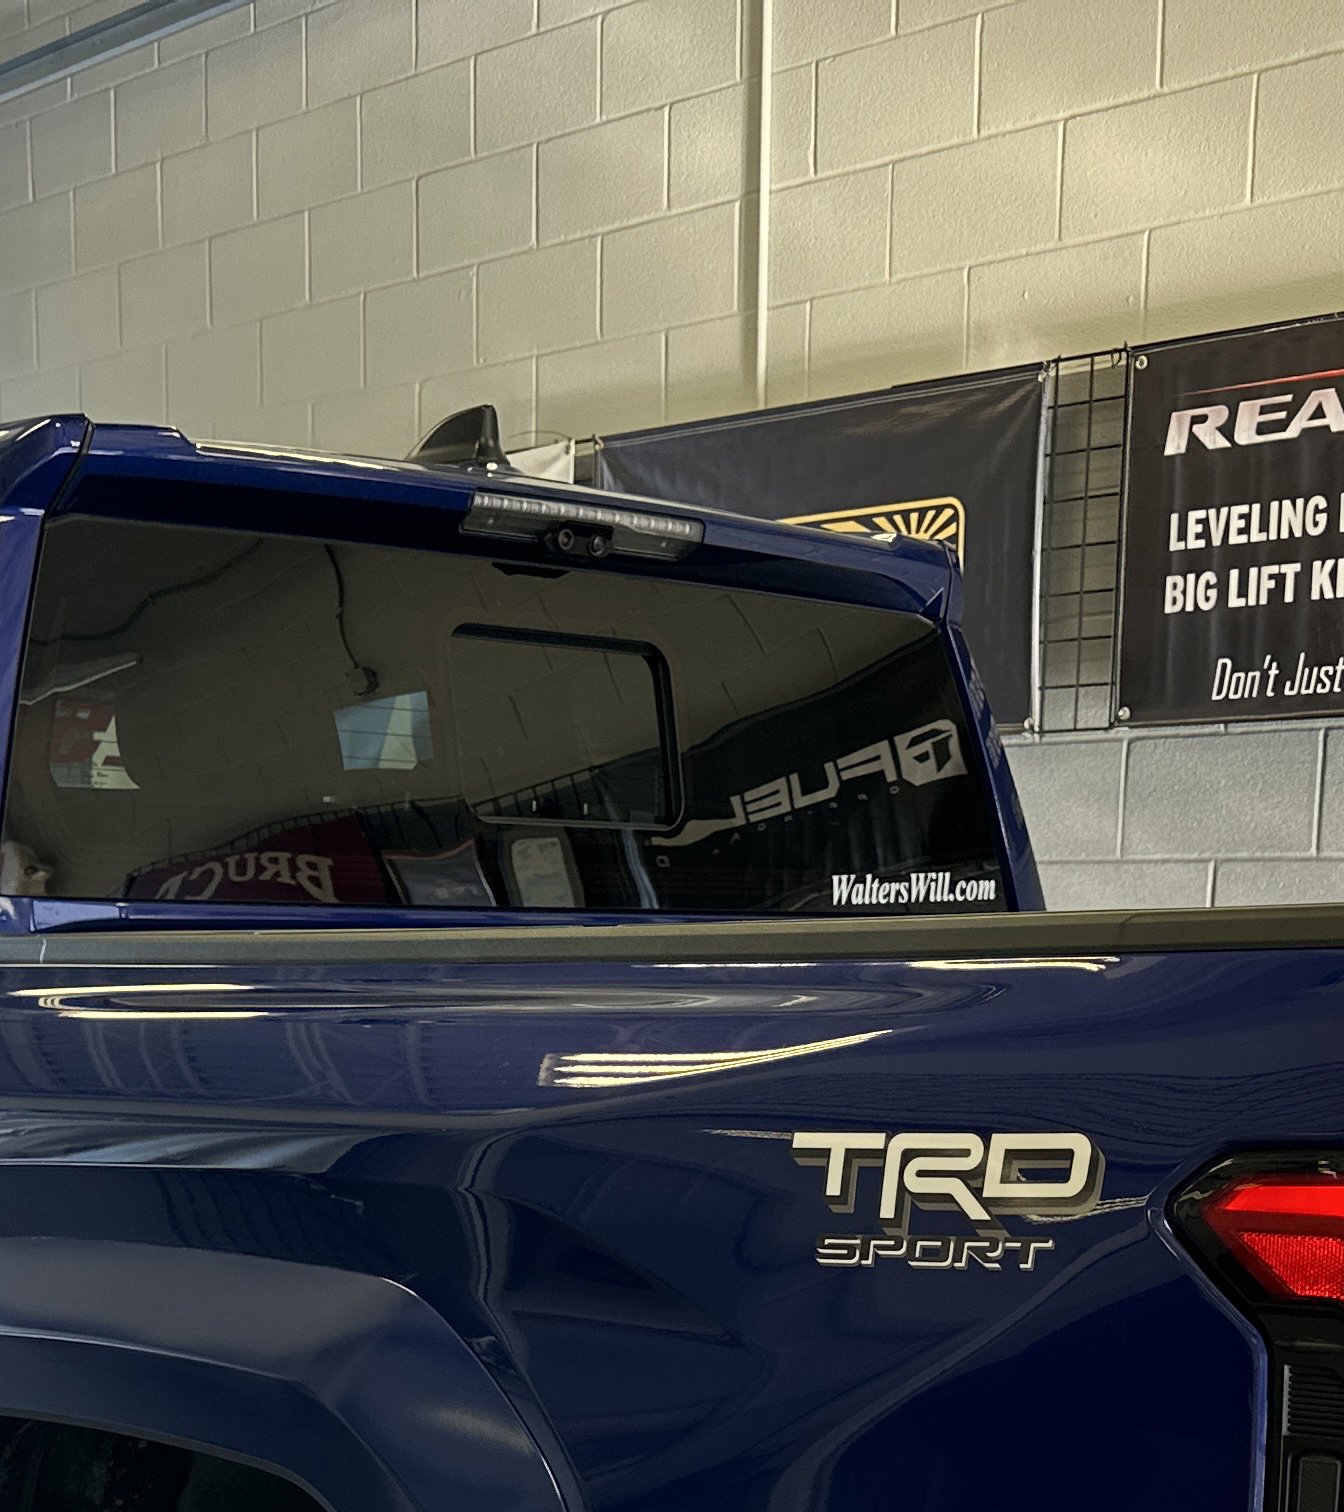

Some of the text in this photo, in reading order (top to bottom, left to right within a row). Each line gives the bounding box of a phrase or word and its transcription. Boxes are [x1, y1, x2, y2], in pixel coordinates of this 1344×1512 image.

[1168, 494, 1329, 552] LEVELING
[1163, 570, 1219, 615] BIG
[1227, 562, 1302, 609] LIFT
[1210, 653, 1280, 701] Don't
[830, 871, 997, 907] WaltersWill.com
[790, 1130, 1107, 1232] TRD
[815, 1234, 1055, 1272] SPORT
